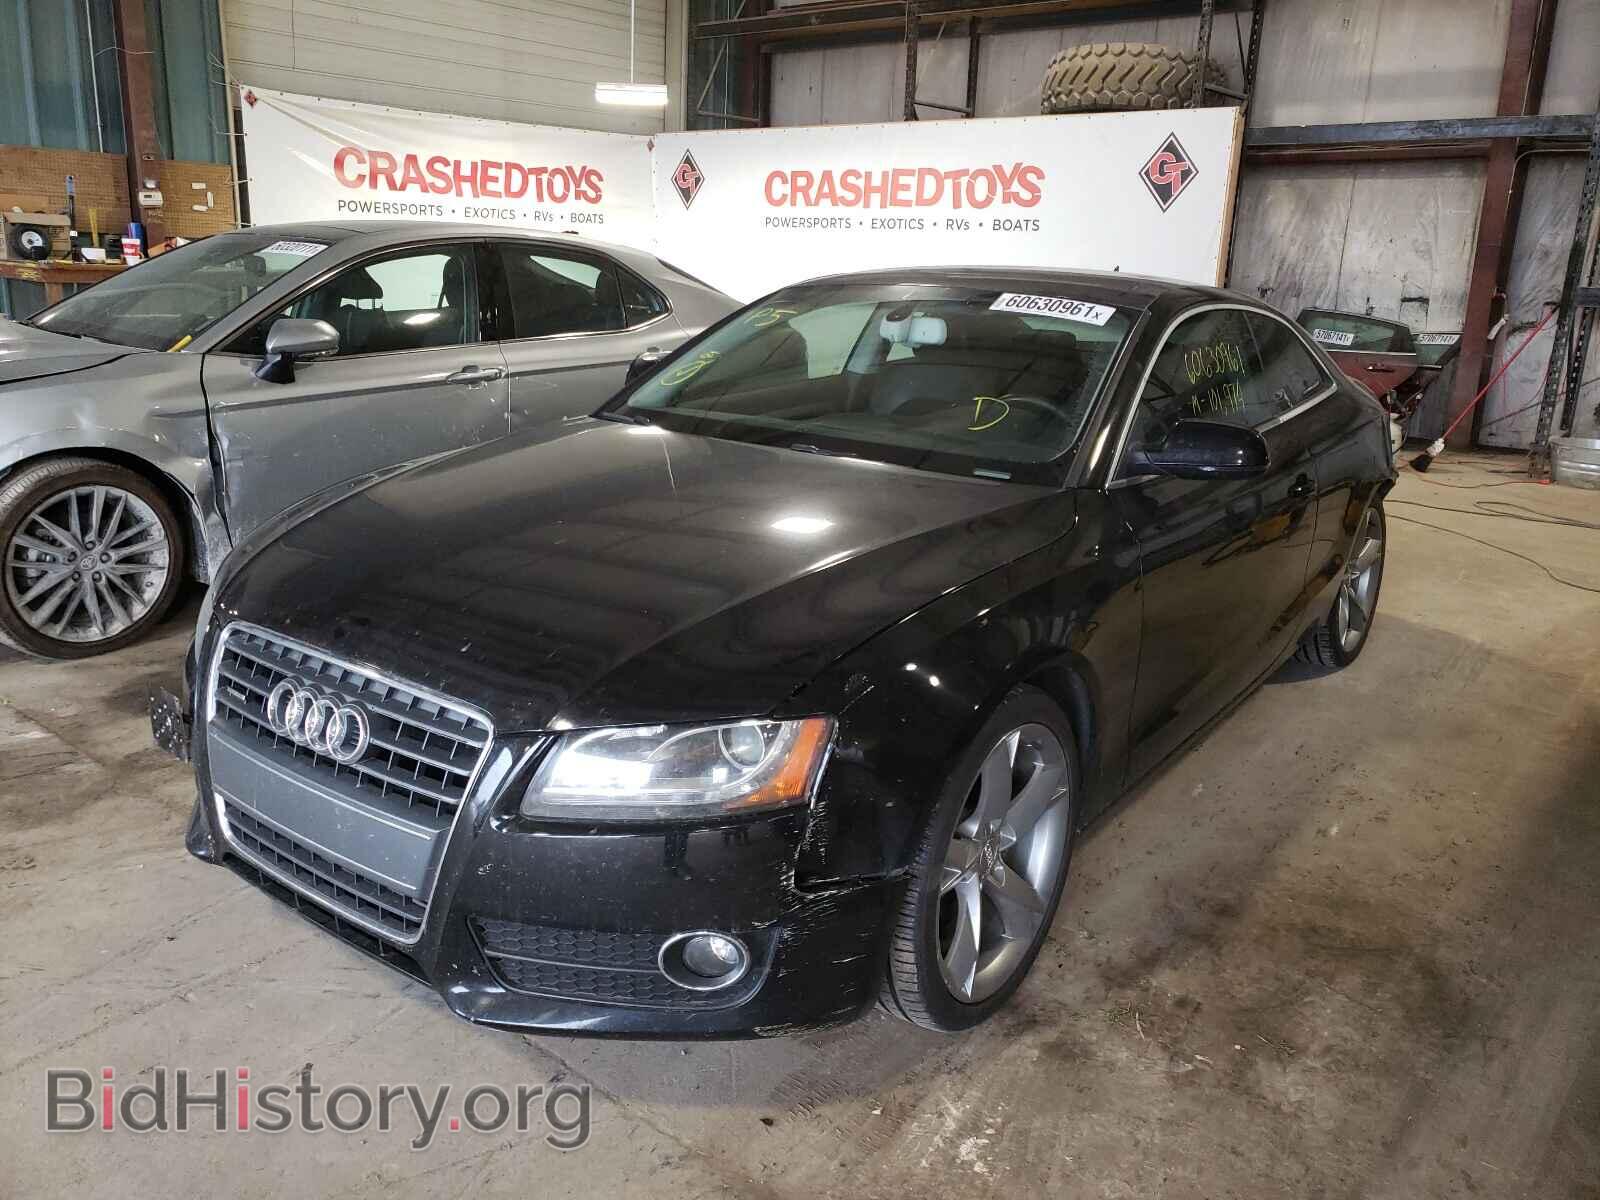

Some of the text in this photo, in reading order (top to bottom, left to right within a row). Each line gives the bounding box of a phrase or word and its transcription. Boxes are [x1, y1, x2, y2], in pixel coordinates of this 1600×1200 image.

[333, 146, 604, 204] CRASHEDTOYS
[764, 162, 1046, 210] CRASHEDTOYS
[338, 199, 604, 225] POWERSPORTS EXOTICS RVs BOATS
[765, 216, 1040, 232] POWERSPORTS EXOTICS RVs BOATS
[967, 396, 1010, 430] D
